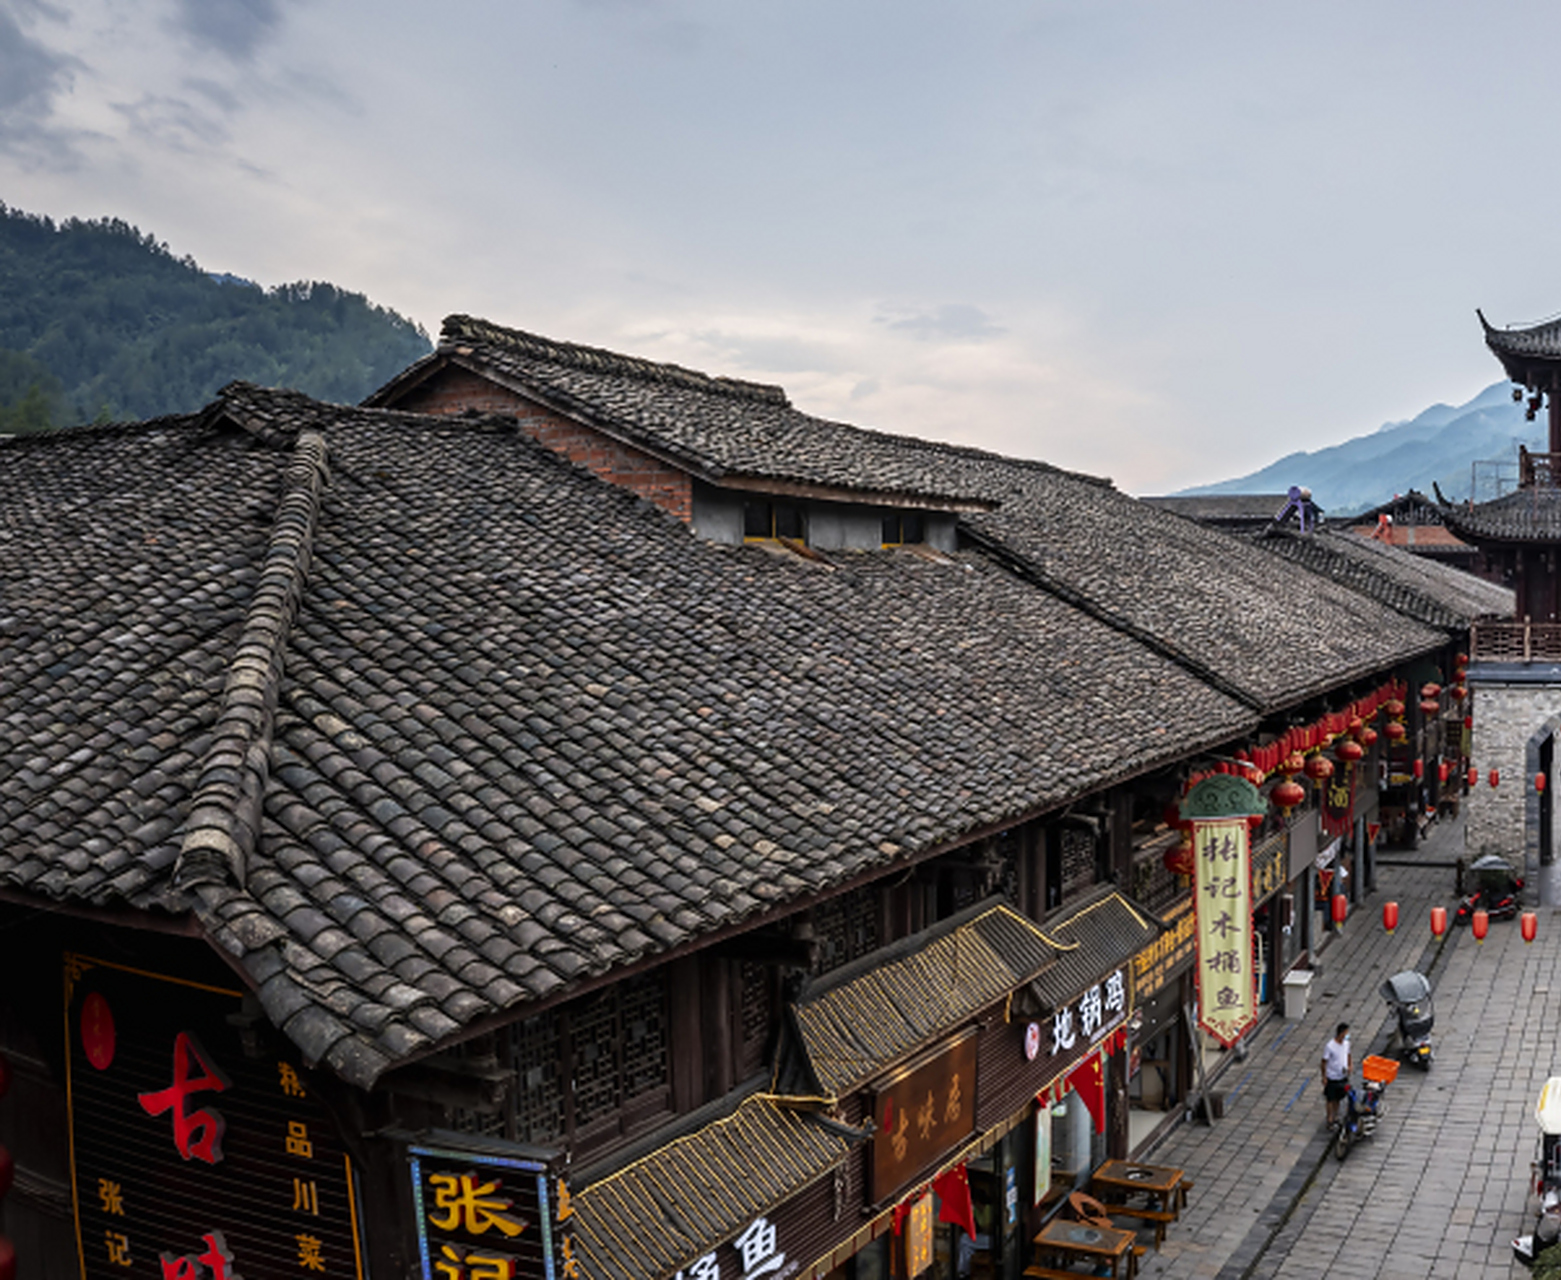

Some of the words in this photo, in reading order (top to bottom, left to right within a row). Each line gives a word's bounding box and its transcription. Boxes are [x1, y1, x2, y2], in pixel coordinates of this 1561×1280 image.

[1203, 834, 1244, 1012] 张记木桶鱼
[98, 1178, 132, 1267] 张记
